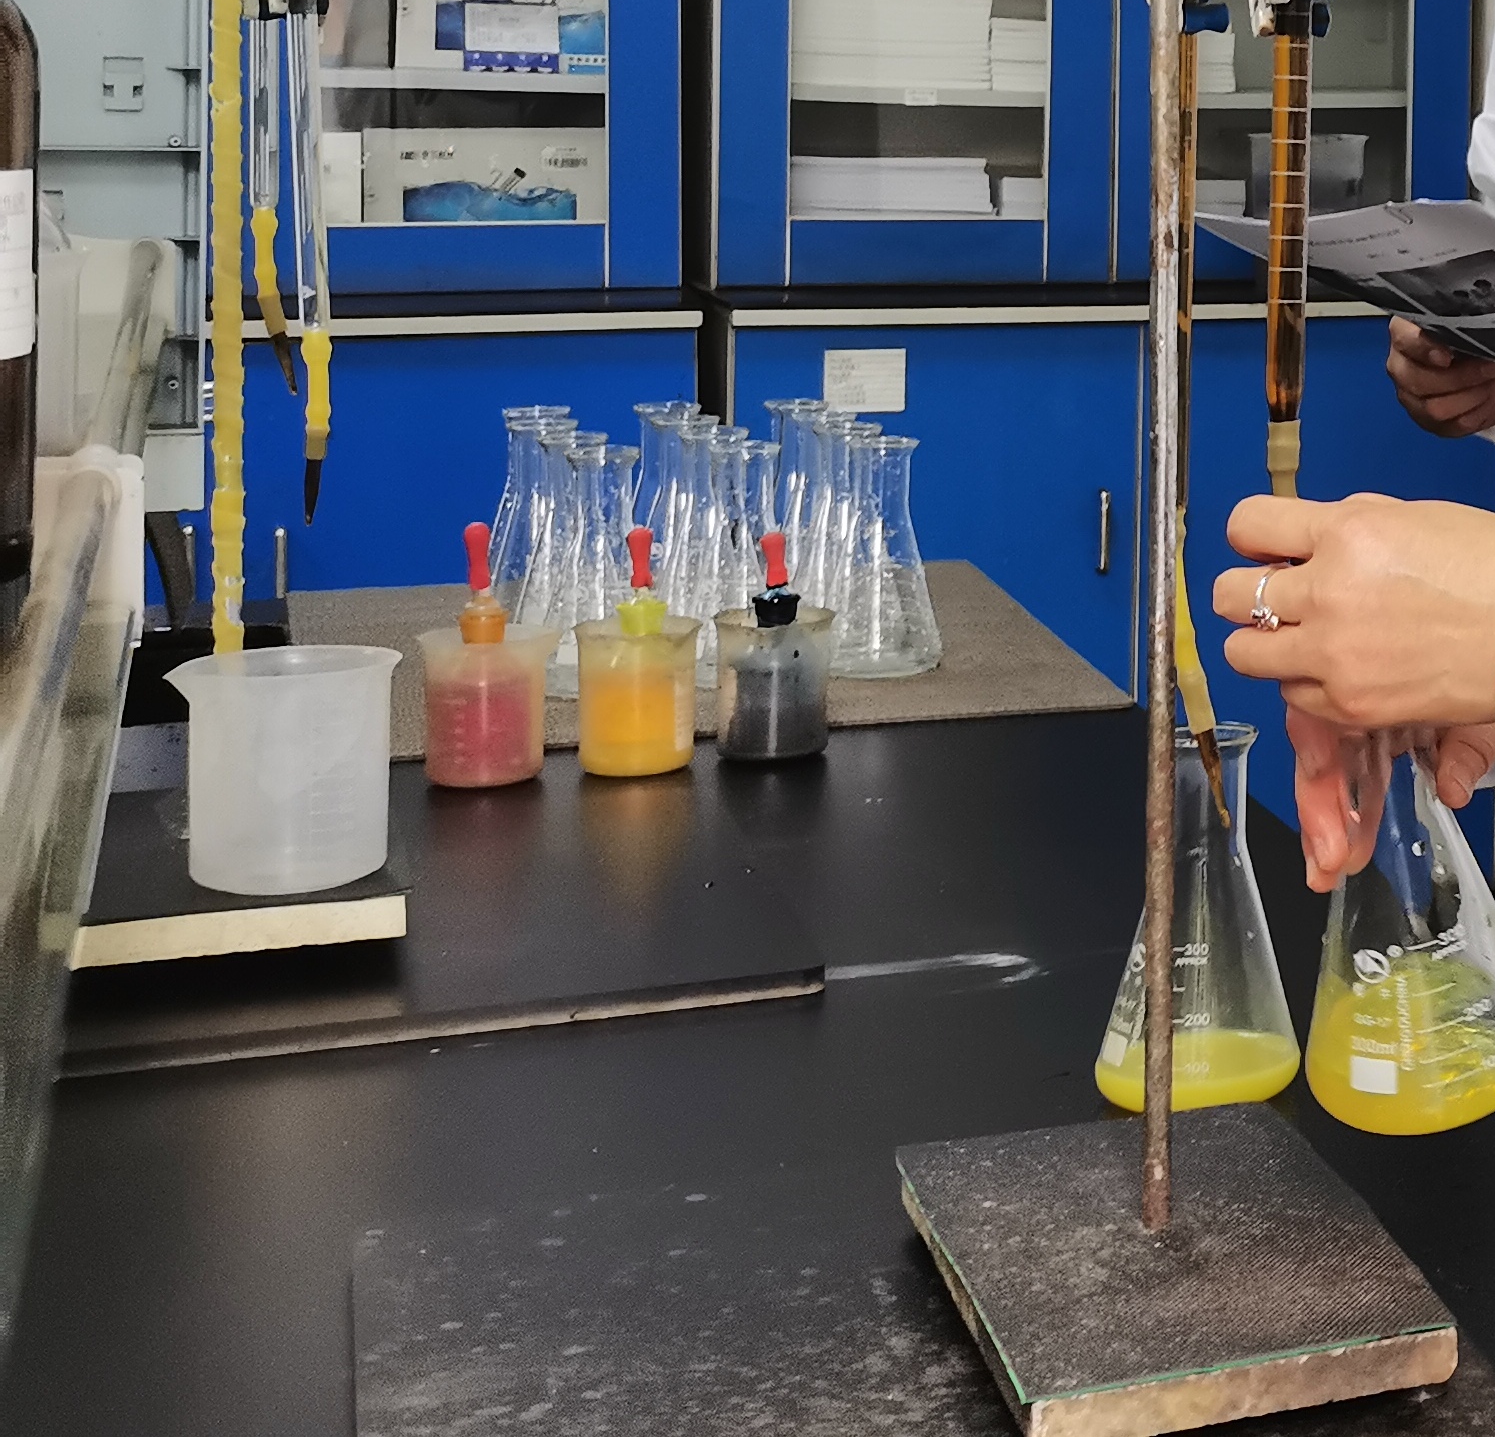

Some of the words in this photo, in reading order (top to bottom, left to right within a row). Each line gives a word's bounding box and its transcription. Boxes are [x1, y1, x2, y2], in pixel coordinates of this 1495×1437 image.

[1184, 943, 1210, 956] 300
[1462, 997, 1492, 1022] 200
[1184, 1013, 1210, 1027] 200
